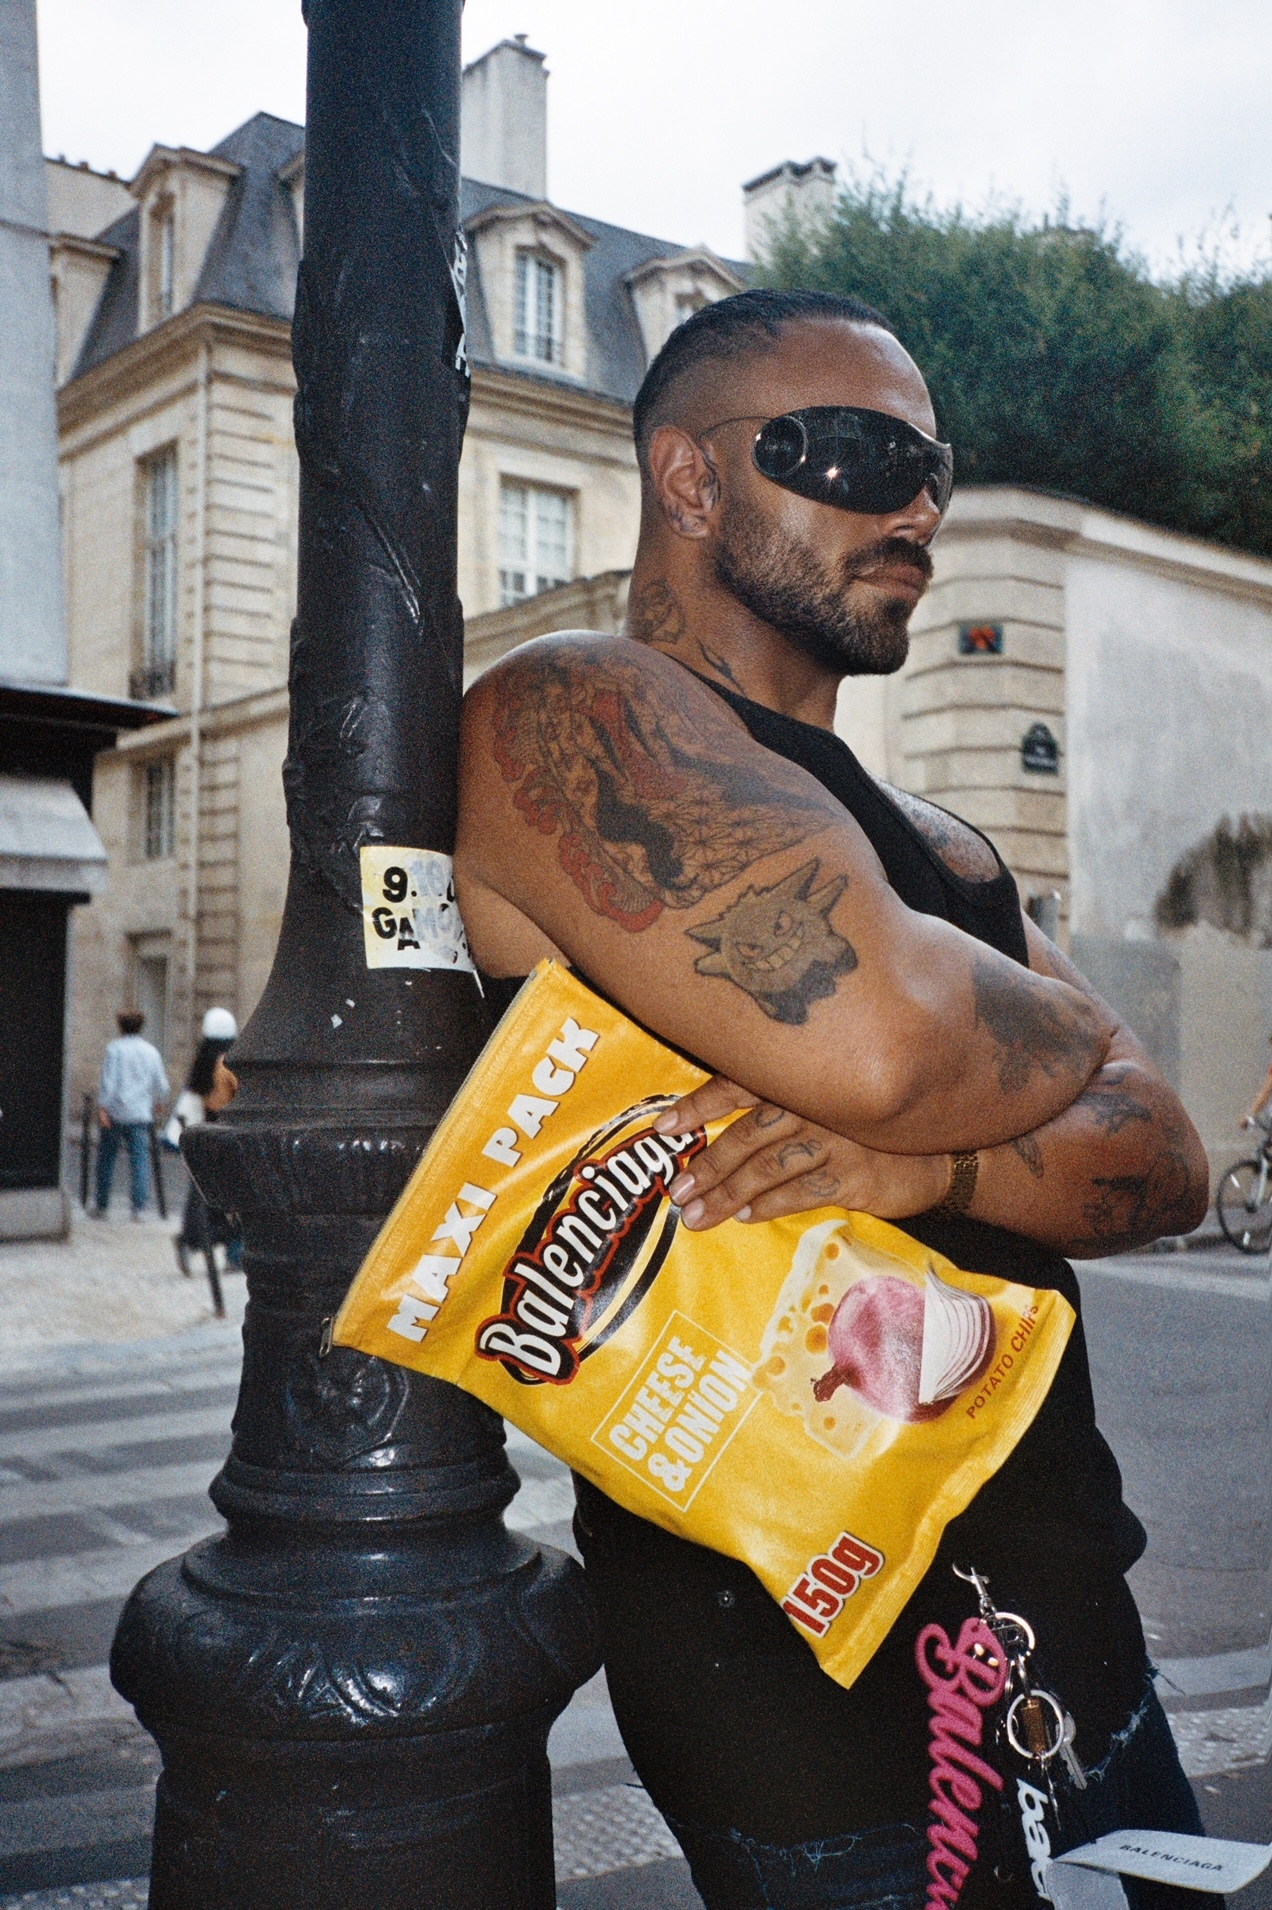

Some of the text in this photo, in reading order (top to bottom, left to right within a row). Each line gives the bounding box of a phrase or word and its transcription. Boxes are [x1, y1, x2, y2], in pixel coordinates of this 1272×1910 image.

[386, 1016, 600, 1344] MAXI PACK
[608, 1335, 707, 1462] CHEESE
[965, 1304, 1039, 1419] POTATO CHIPS
[780, 1531, 885, 1638] 150g
[1119, 1843, 1223, 1872] BALENCIAGA
